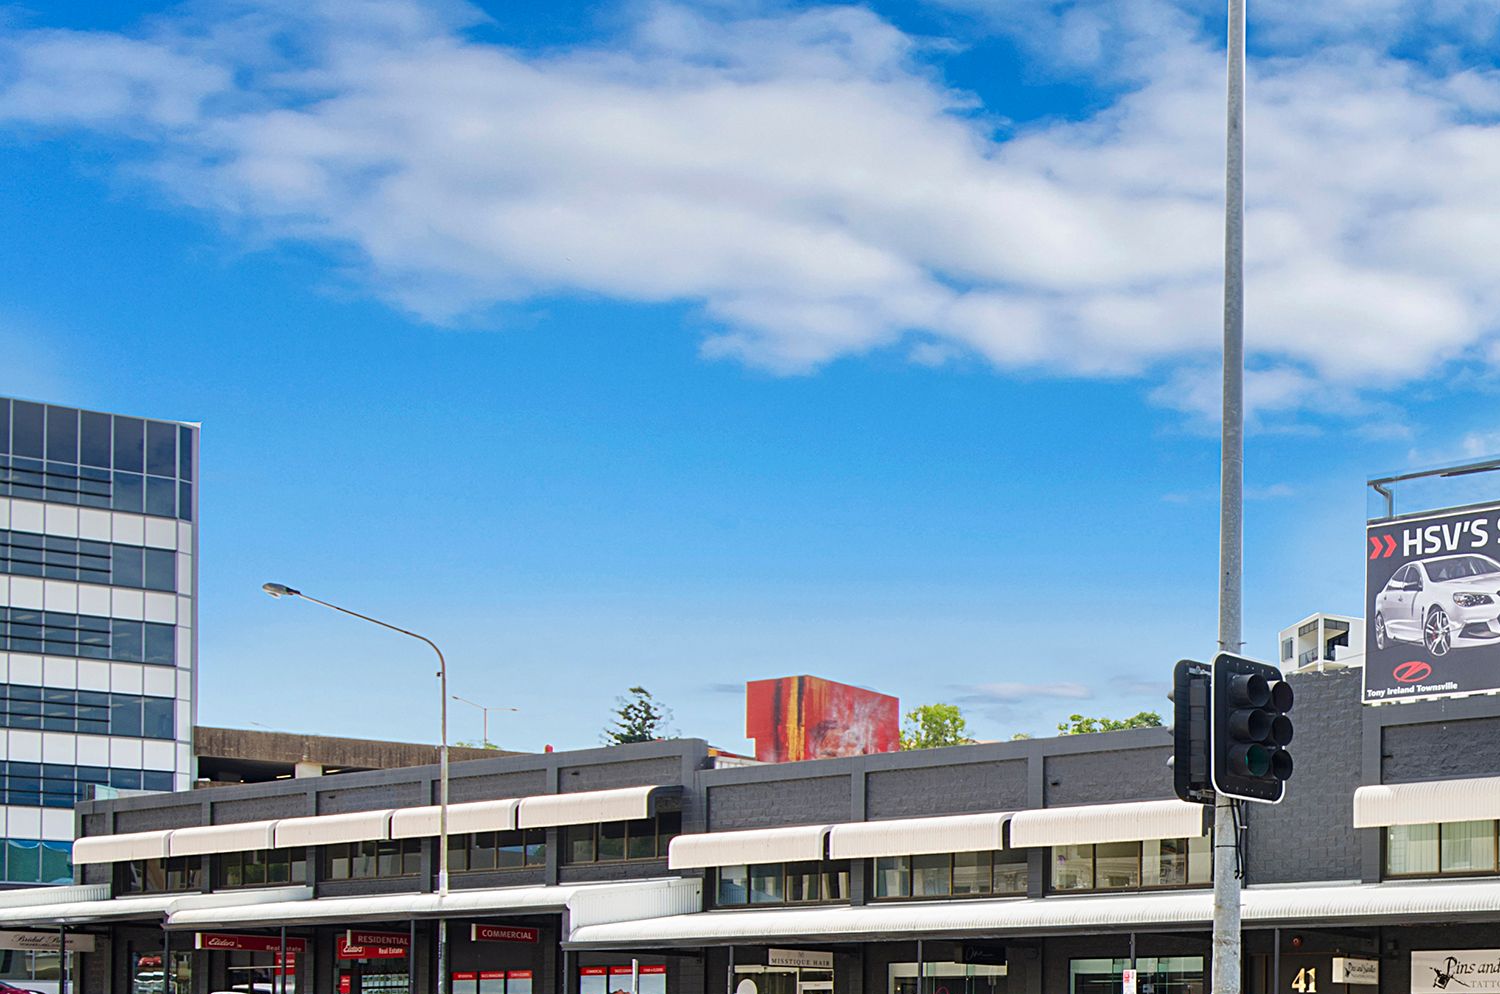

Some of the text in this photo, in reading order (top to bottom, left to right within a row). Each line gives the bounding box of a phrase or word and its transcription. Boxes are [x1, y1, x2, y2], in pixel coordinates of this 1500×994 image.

[1403, 518, 1489, 557] HSV'S
[1366, 681, 1458, 698] Tony Ireland Townsville
[357, 935, 409, 945] RESIDENTIAL
[481, 929, 533, 940] COMMERCIAL
[771, 958, 810, 966] MISSTIQUE
[1443, 956, 1475, 976] Pins
[1292, 967, 1317, 993] 41
